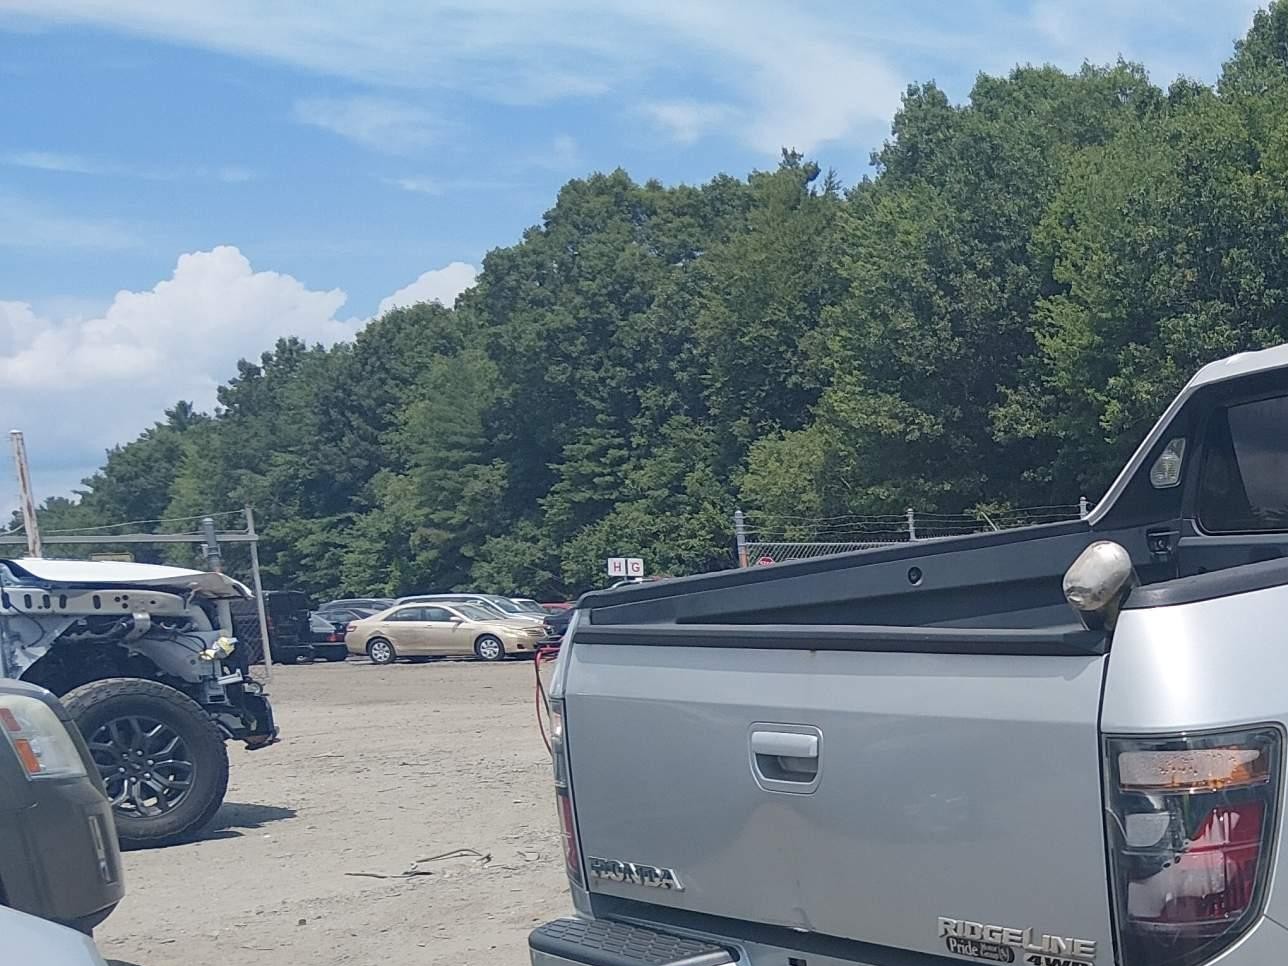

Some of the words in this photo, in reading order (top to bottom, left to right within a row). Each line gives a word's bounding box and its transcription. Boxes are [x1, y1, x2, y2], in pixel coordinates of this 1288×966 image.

[613, 561, 622, 572] H
[631, 562, 641, 573] G
[588, 856, 684, 892] HONDA
[938, 916, 1097, 958] RIDGELINE
[949, 937, 979, 957] Pride
